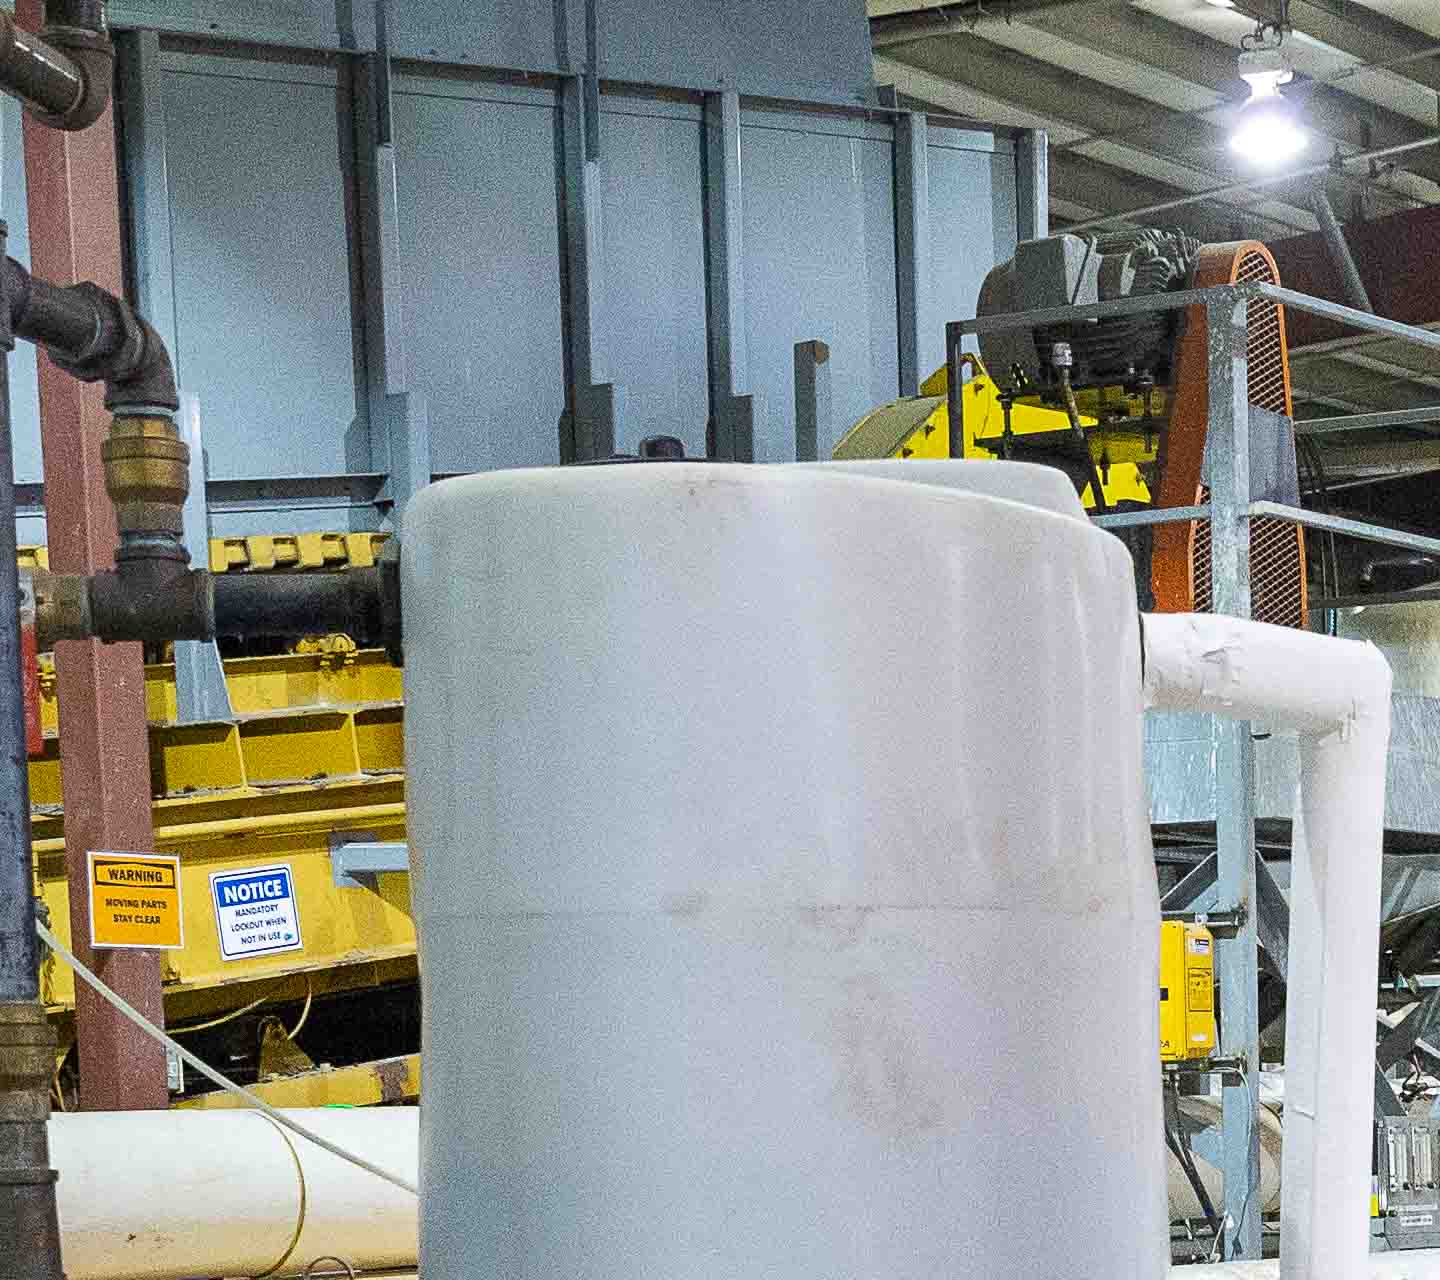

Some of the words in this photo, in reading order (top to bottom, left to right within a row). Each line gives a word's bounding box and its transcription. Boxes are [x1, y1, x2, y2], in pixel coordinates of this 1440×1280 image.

[108, 868, 162, 882] WARNING
[223, 879, 282, 904] NOTICE
[105, 898, 139, 908] MOVING
[141, 899, 167, 909] PARTS
[234, 904, 279, 917] MANDATORY
[113, 914, 133, 922] STAY
[134, 915, 160, 924] CLEAR
[231, 920, 263, 932] LOCKOUT
[265, 917, 287, 927] WHEN
[241, 936, 256, 945] NOT
[258, 934, 266, 942] IN
[268, 931, 281, 941] USE
